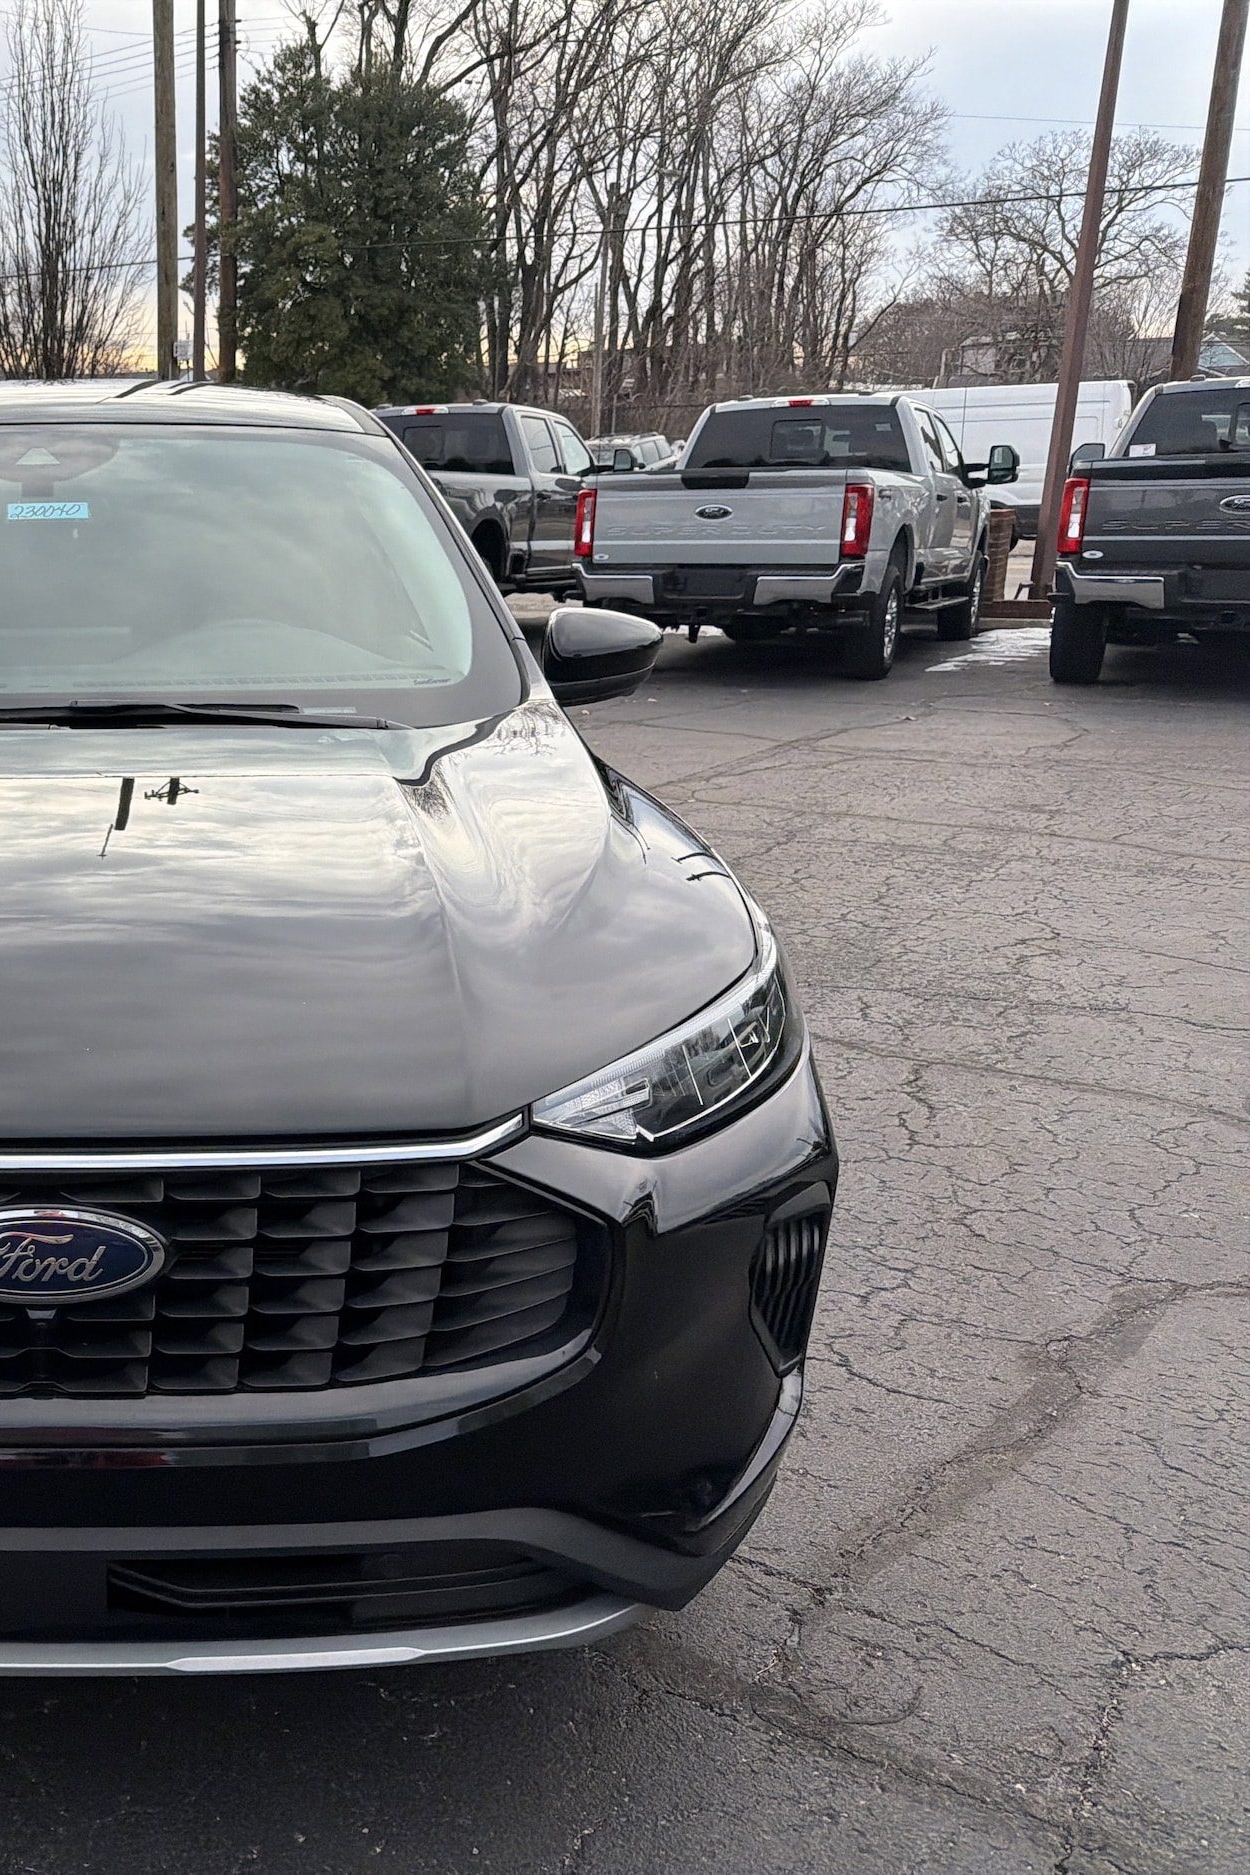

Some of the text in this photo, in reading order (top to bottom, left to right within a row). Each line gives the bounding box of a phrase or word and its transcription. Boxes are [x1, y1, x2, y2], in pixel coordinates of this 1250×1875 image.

[11, 503, 81, 519] 230040
[607, 525, 826, 536] SUPER DUTY
